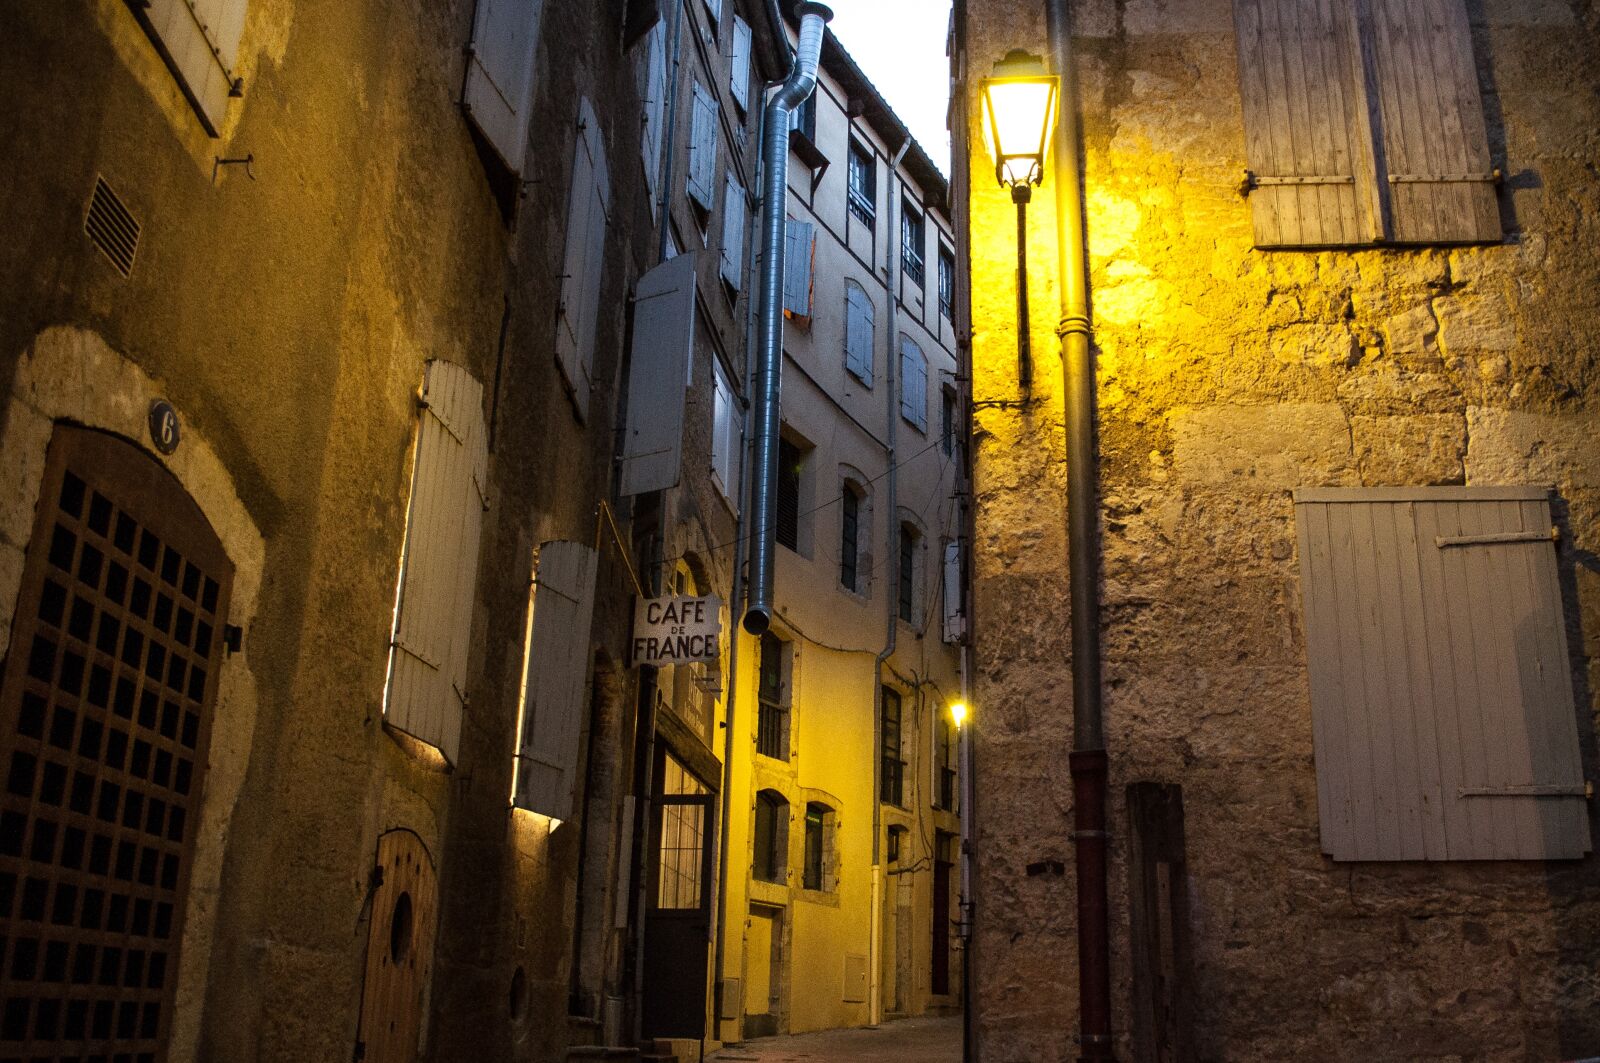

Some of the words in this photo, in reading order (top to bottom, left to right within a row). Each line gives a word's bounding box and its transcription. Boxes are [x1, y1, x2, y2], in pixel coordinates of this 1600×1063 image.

[162, 411, 174, 444] 6
[648, 601, 705, 625] CAFE
[671, 627, 685, 635] DE
[633, 635, 715, 660] FRANCE
